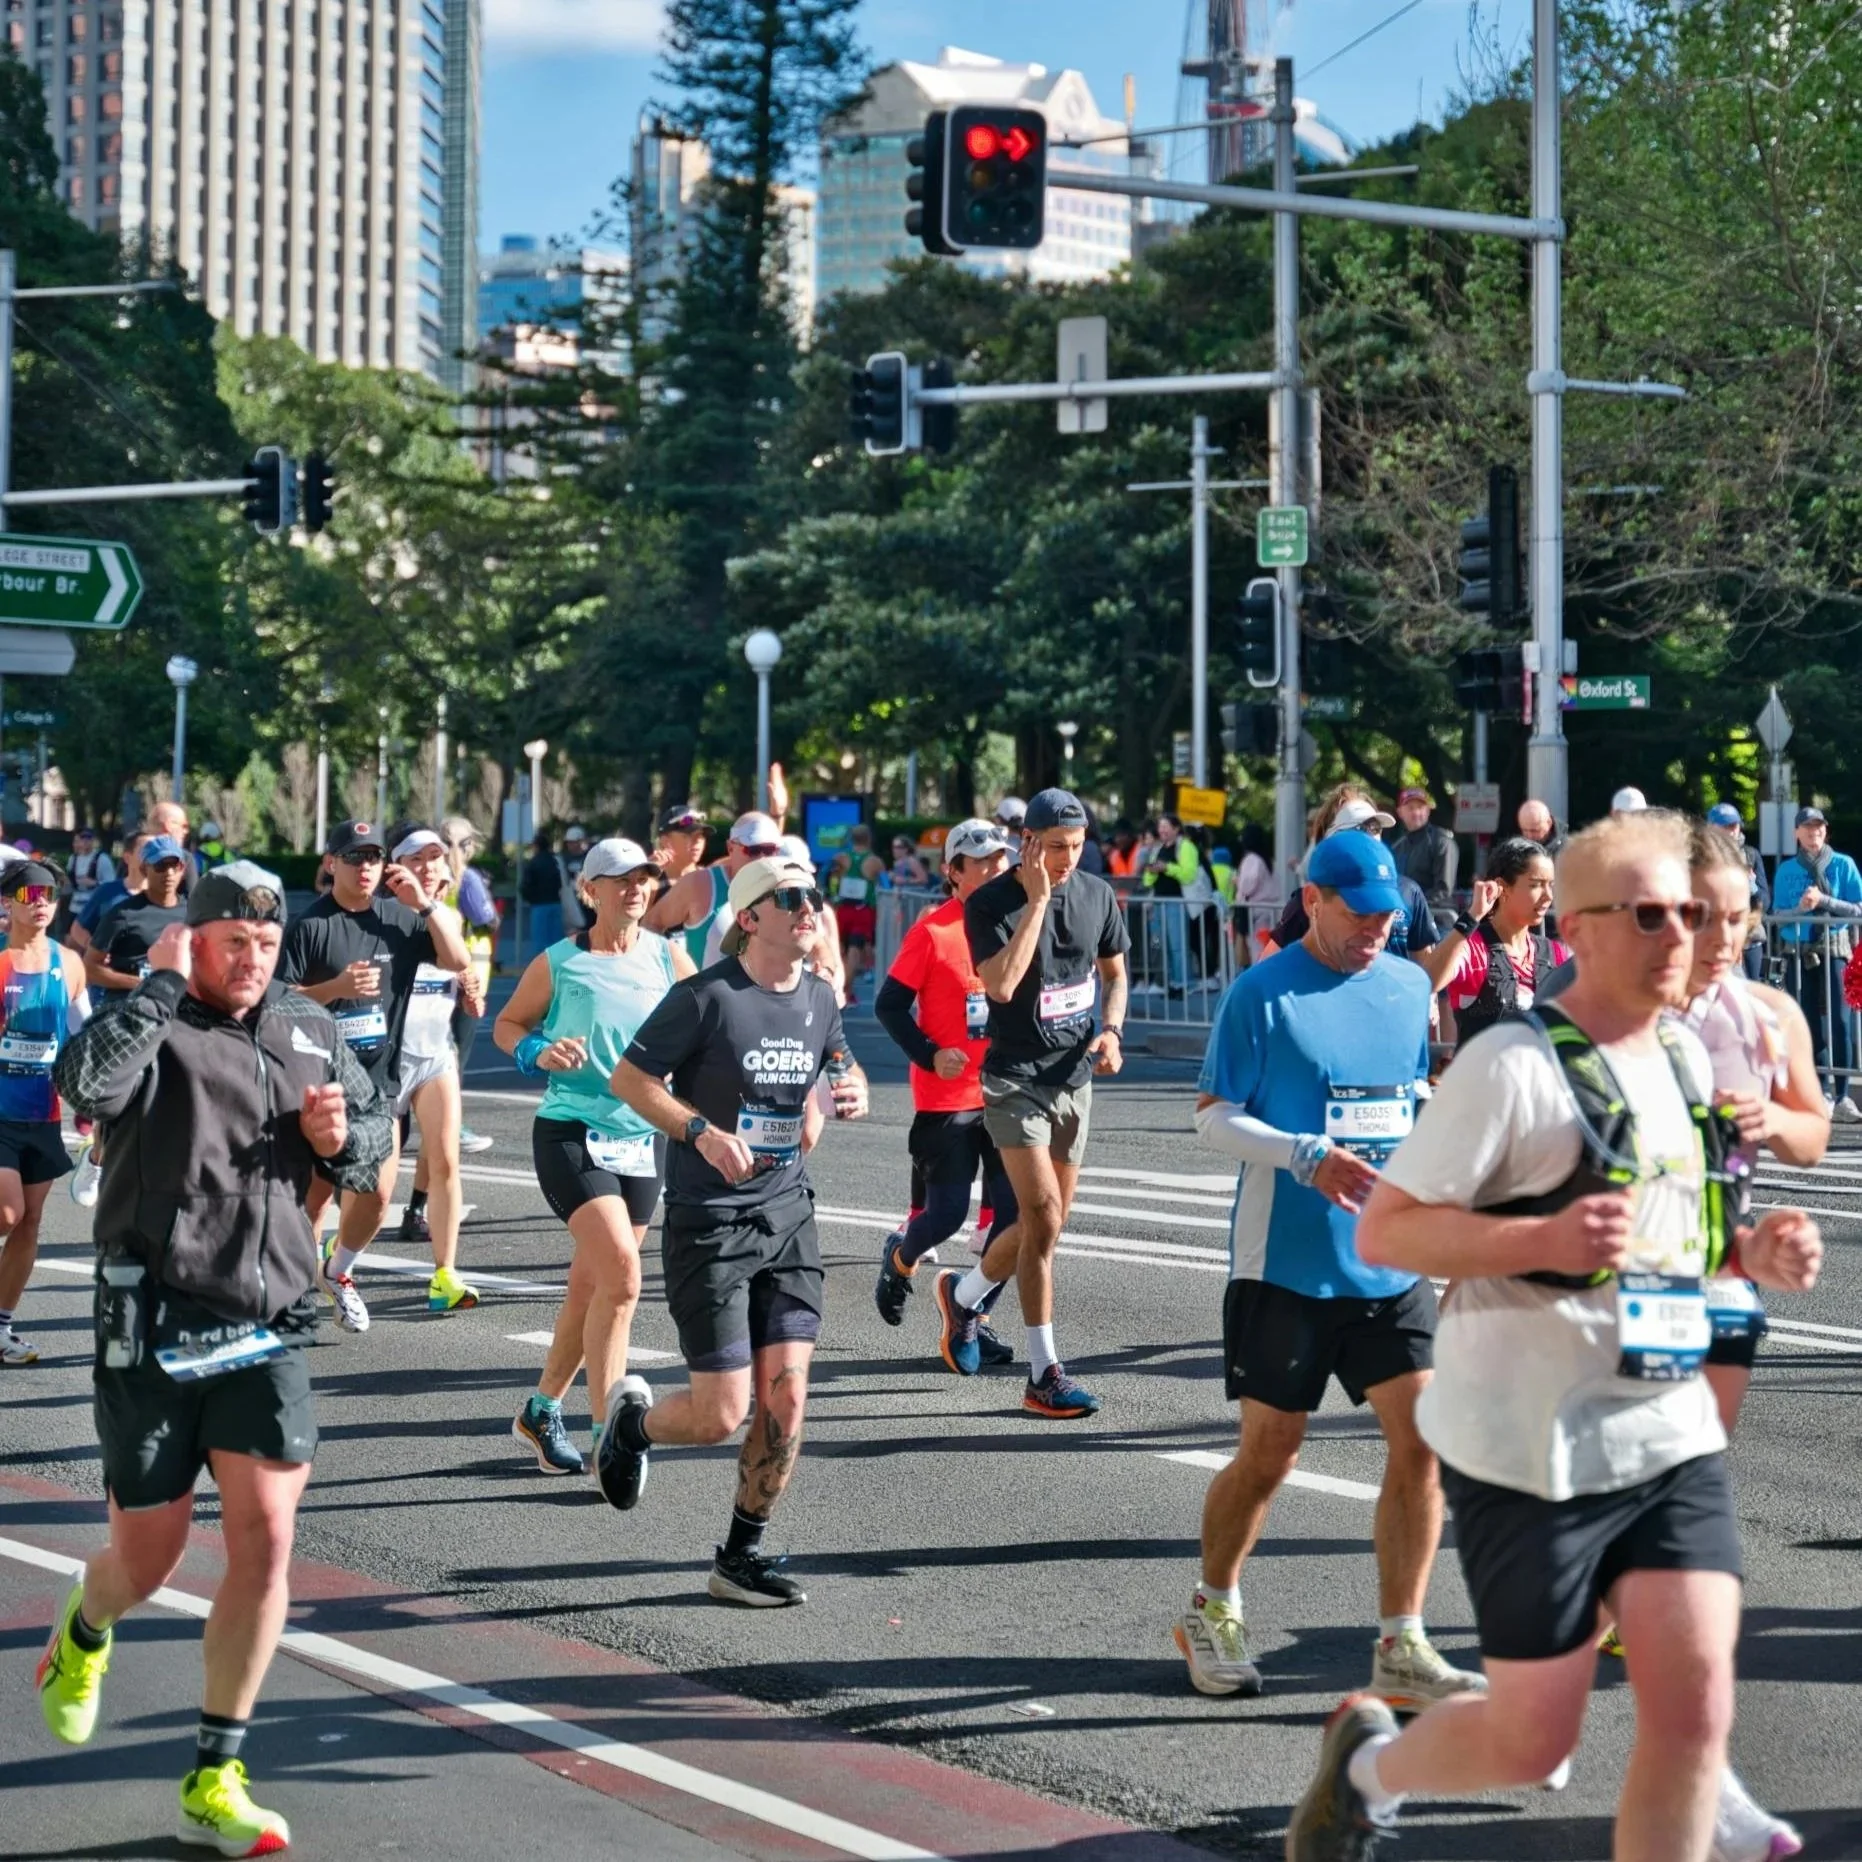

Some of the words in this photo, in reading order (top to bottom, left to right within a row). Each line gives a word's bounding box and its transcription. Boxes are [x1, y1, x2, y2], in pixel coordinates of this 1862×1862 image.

[36, 550, 85, 566] STREET
[0, 571, 45, 592] bour
[1580, 680, 1622, 698] Oxford
[1624, 679, 1637, 697] St
[760, 1036, 785, 1048] Good
[786, 1037, 804, 1051] Day
[742, 1049, 814, 1072] GOERS
[753, 1071, 779, 1084] RUN
[778, 1072, 807, 1085] CLUB
